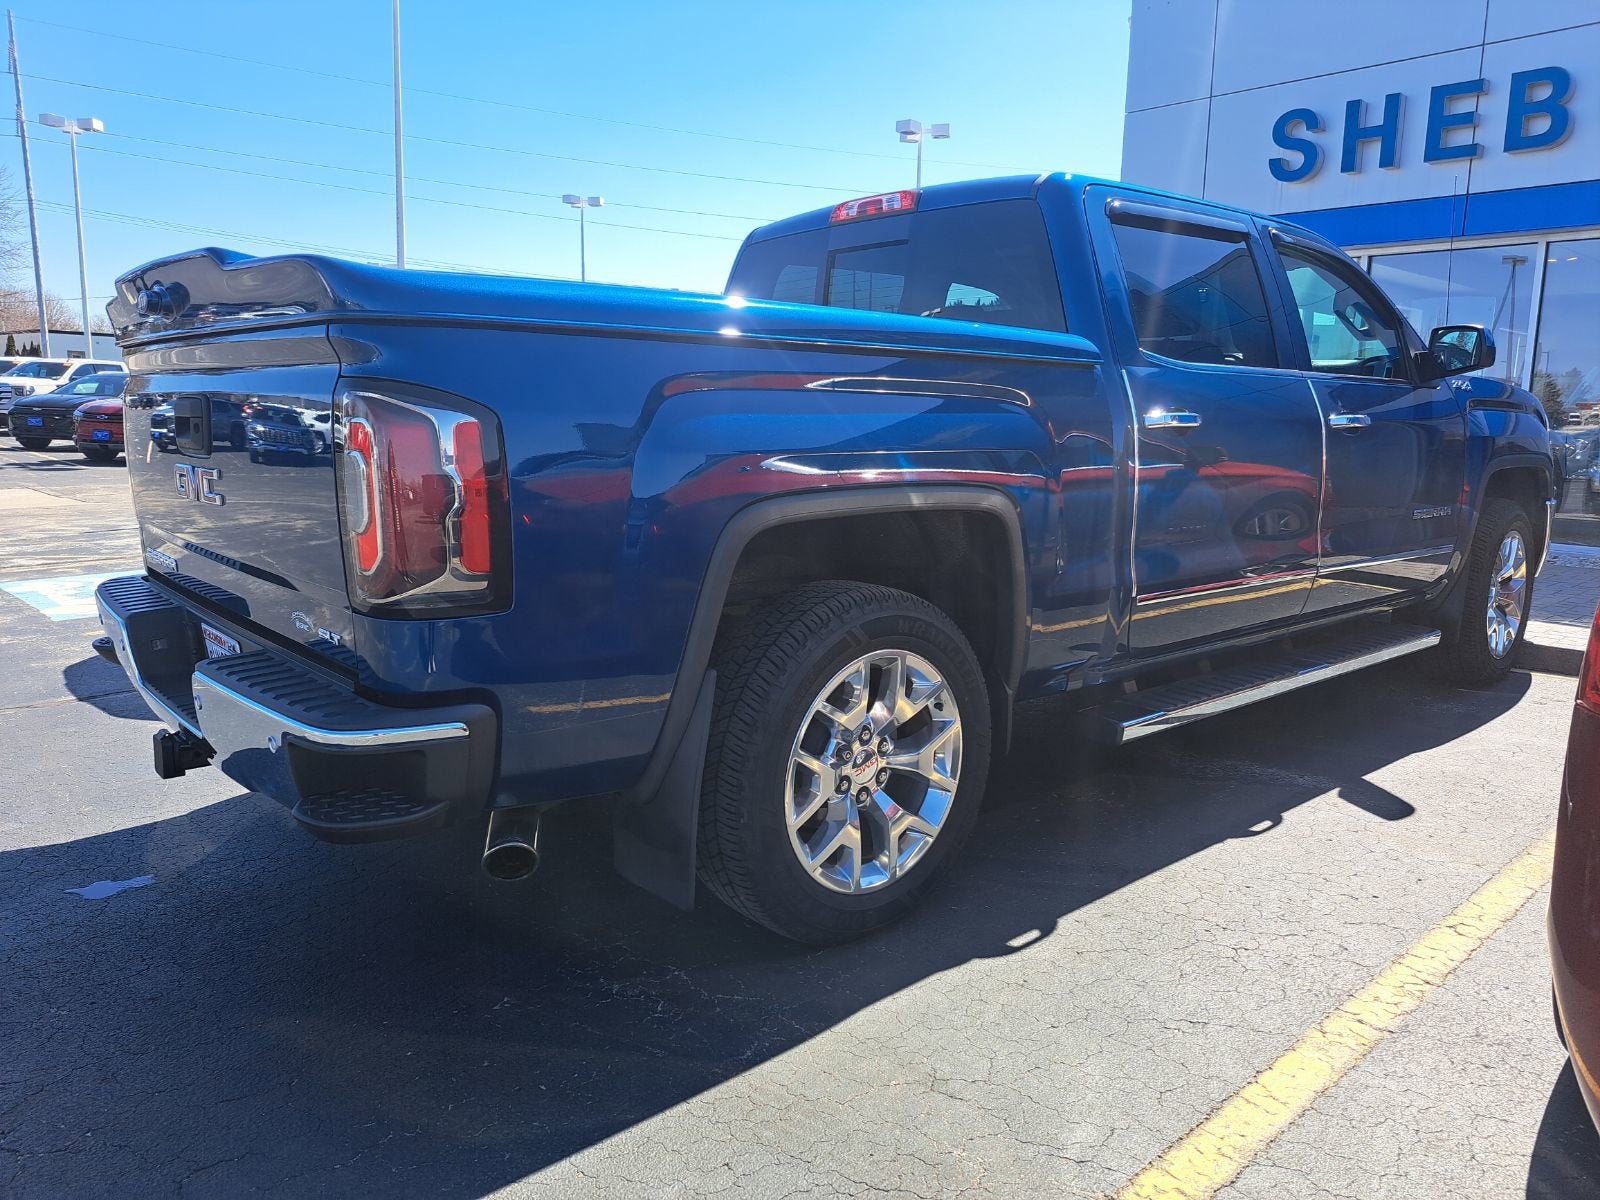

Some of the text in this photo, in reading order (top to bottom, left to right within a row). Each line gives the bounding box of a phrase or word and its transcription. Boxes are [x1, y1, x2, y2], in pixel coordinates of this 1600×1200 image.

[1268, 66, 1575, 183] SHEB
[174, 463, 225, 505] GMC
[318, 627, 341, 646] SLT
